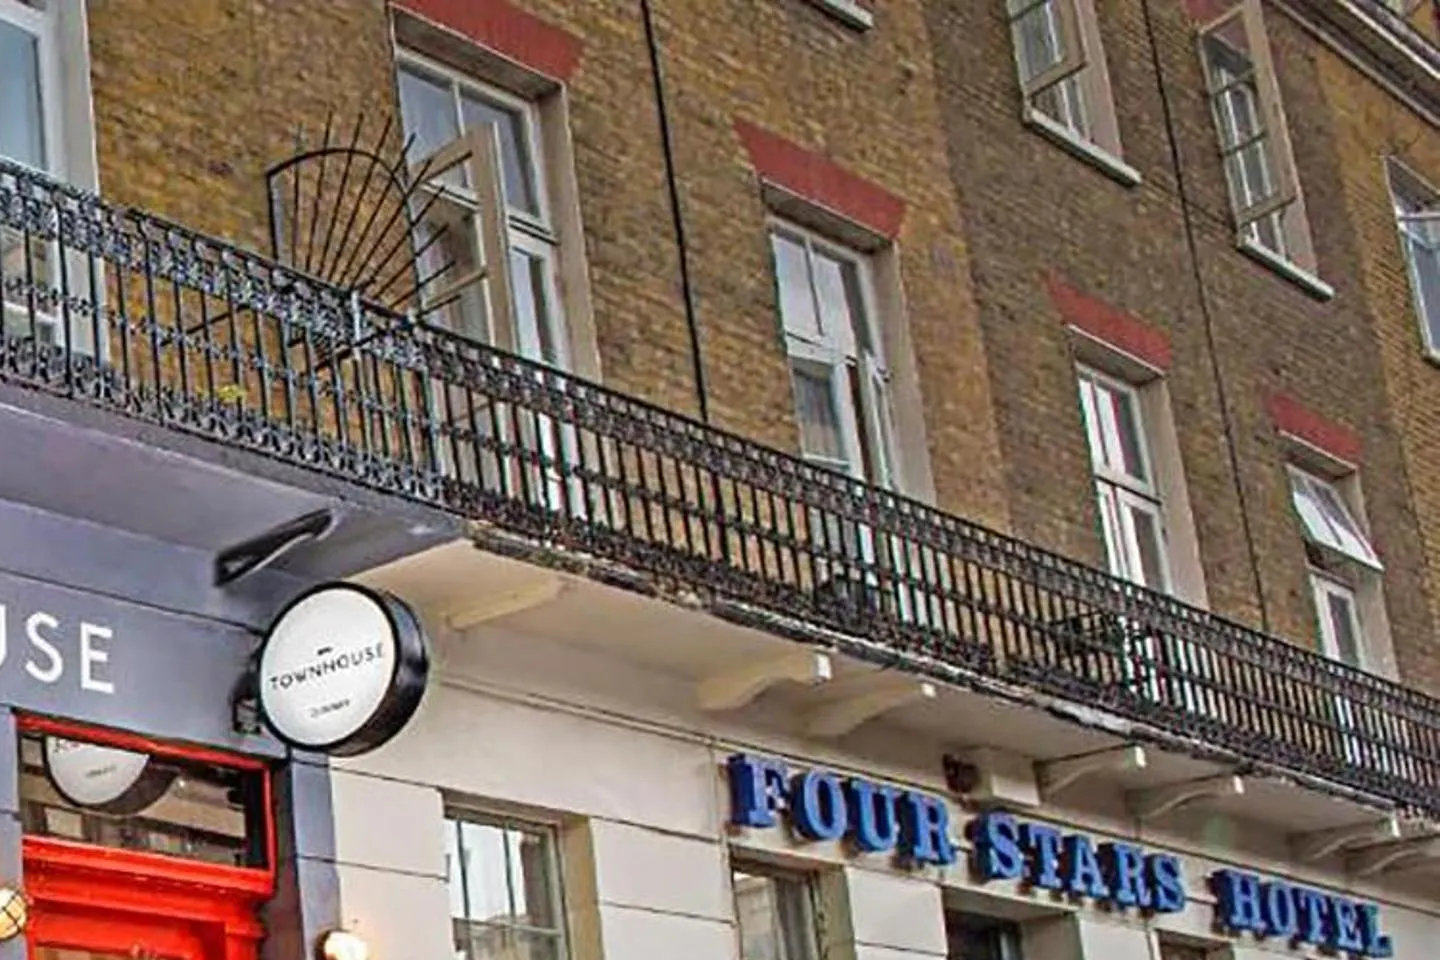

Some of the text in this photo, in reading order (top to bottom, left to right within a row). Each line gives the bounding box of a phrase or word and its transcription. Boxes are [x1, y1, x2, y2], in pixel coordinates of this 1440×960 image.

[269, 642, 384, 690] TOWNHOUSE
[730, 752, 1393, 958] FOUR STARS HOTEL
